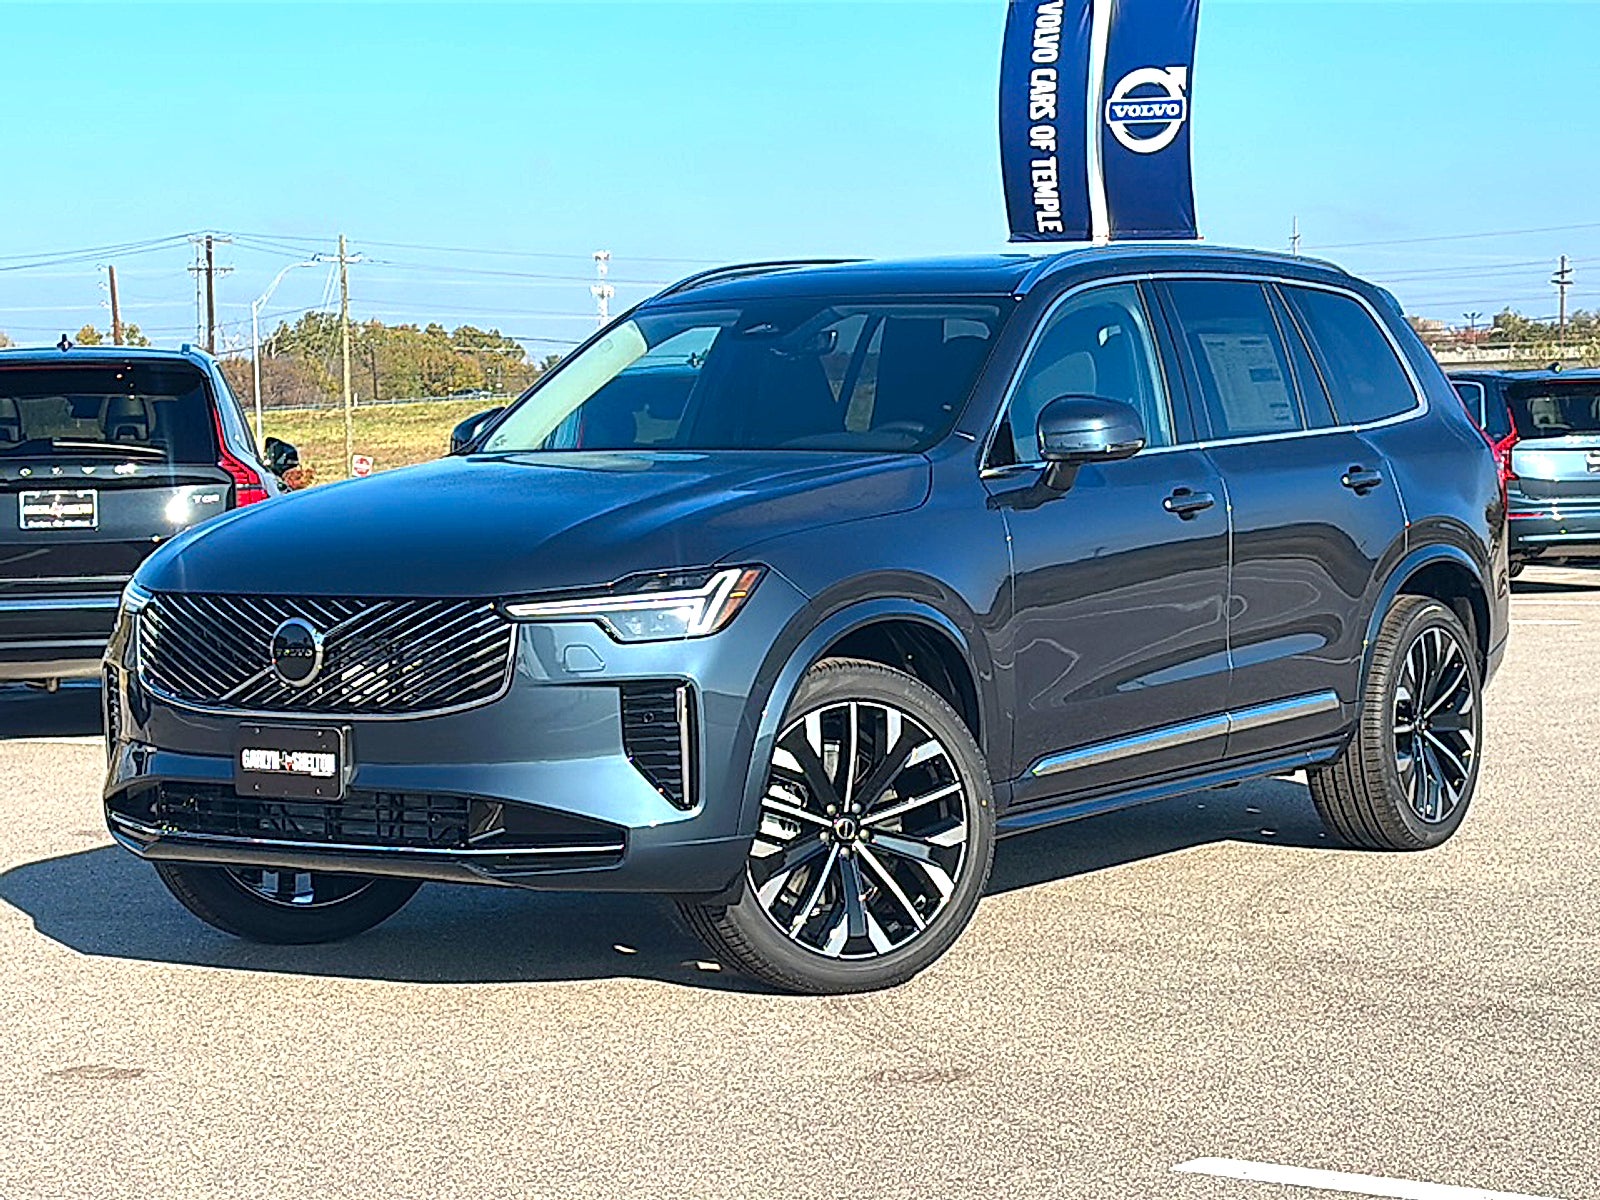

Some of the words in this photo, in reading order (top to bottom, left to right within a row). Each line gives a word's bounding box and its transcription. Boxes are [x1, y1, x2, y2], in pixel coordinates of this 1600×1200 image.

[1032, 0, 1063, 63] VOLVO
[1030, 68, 1056, 120] CARS
[1112, 103, 1179, 118] VOLVO
[1030, 125, 1056, 151] OF
[1032, 156, 1063, 233] TEMPLE
